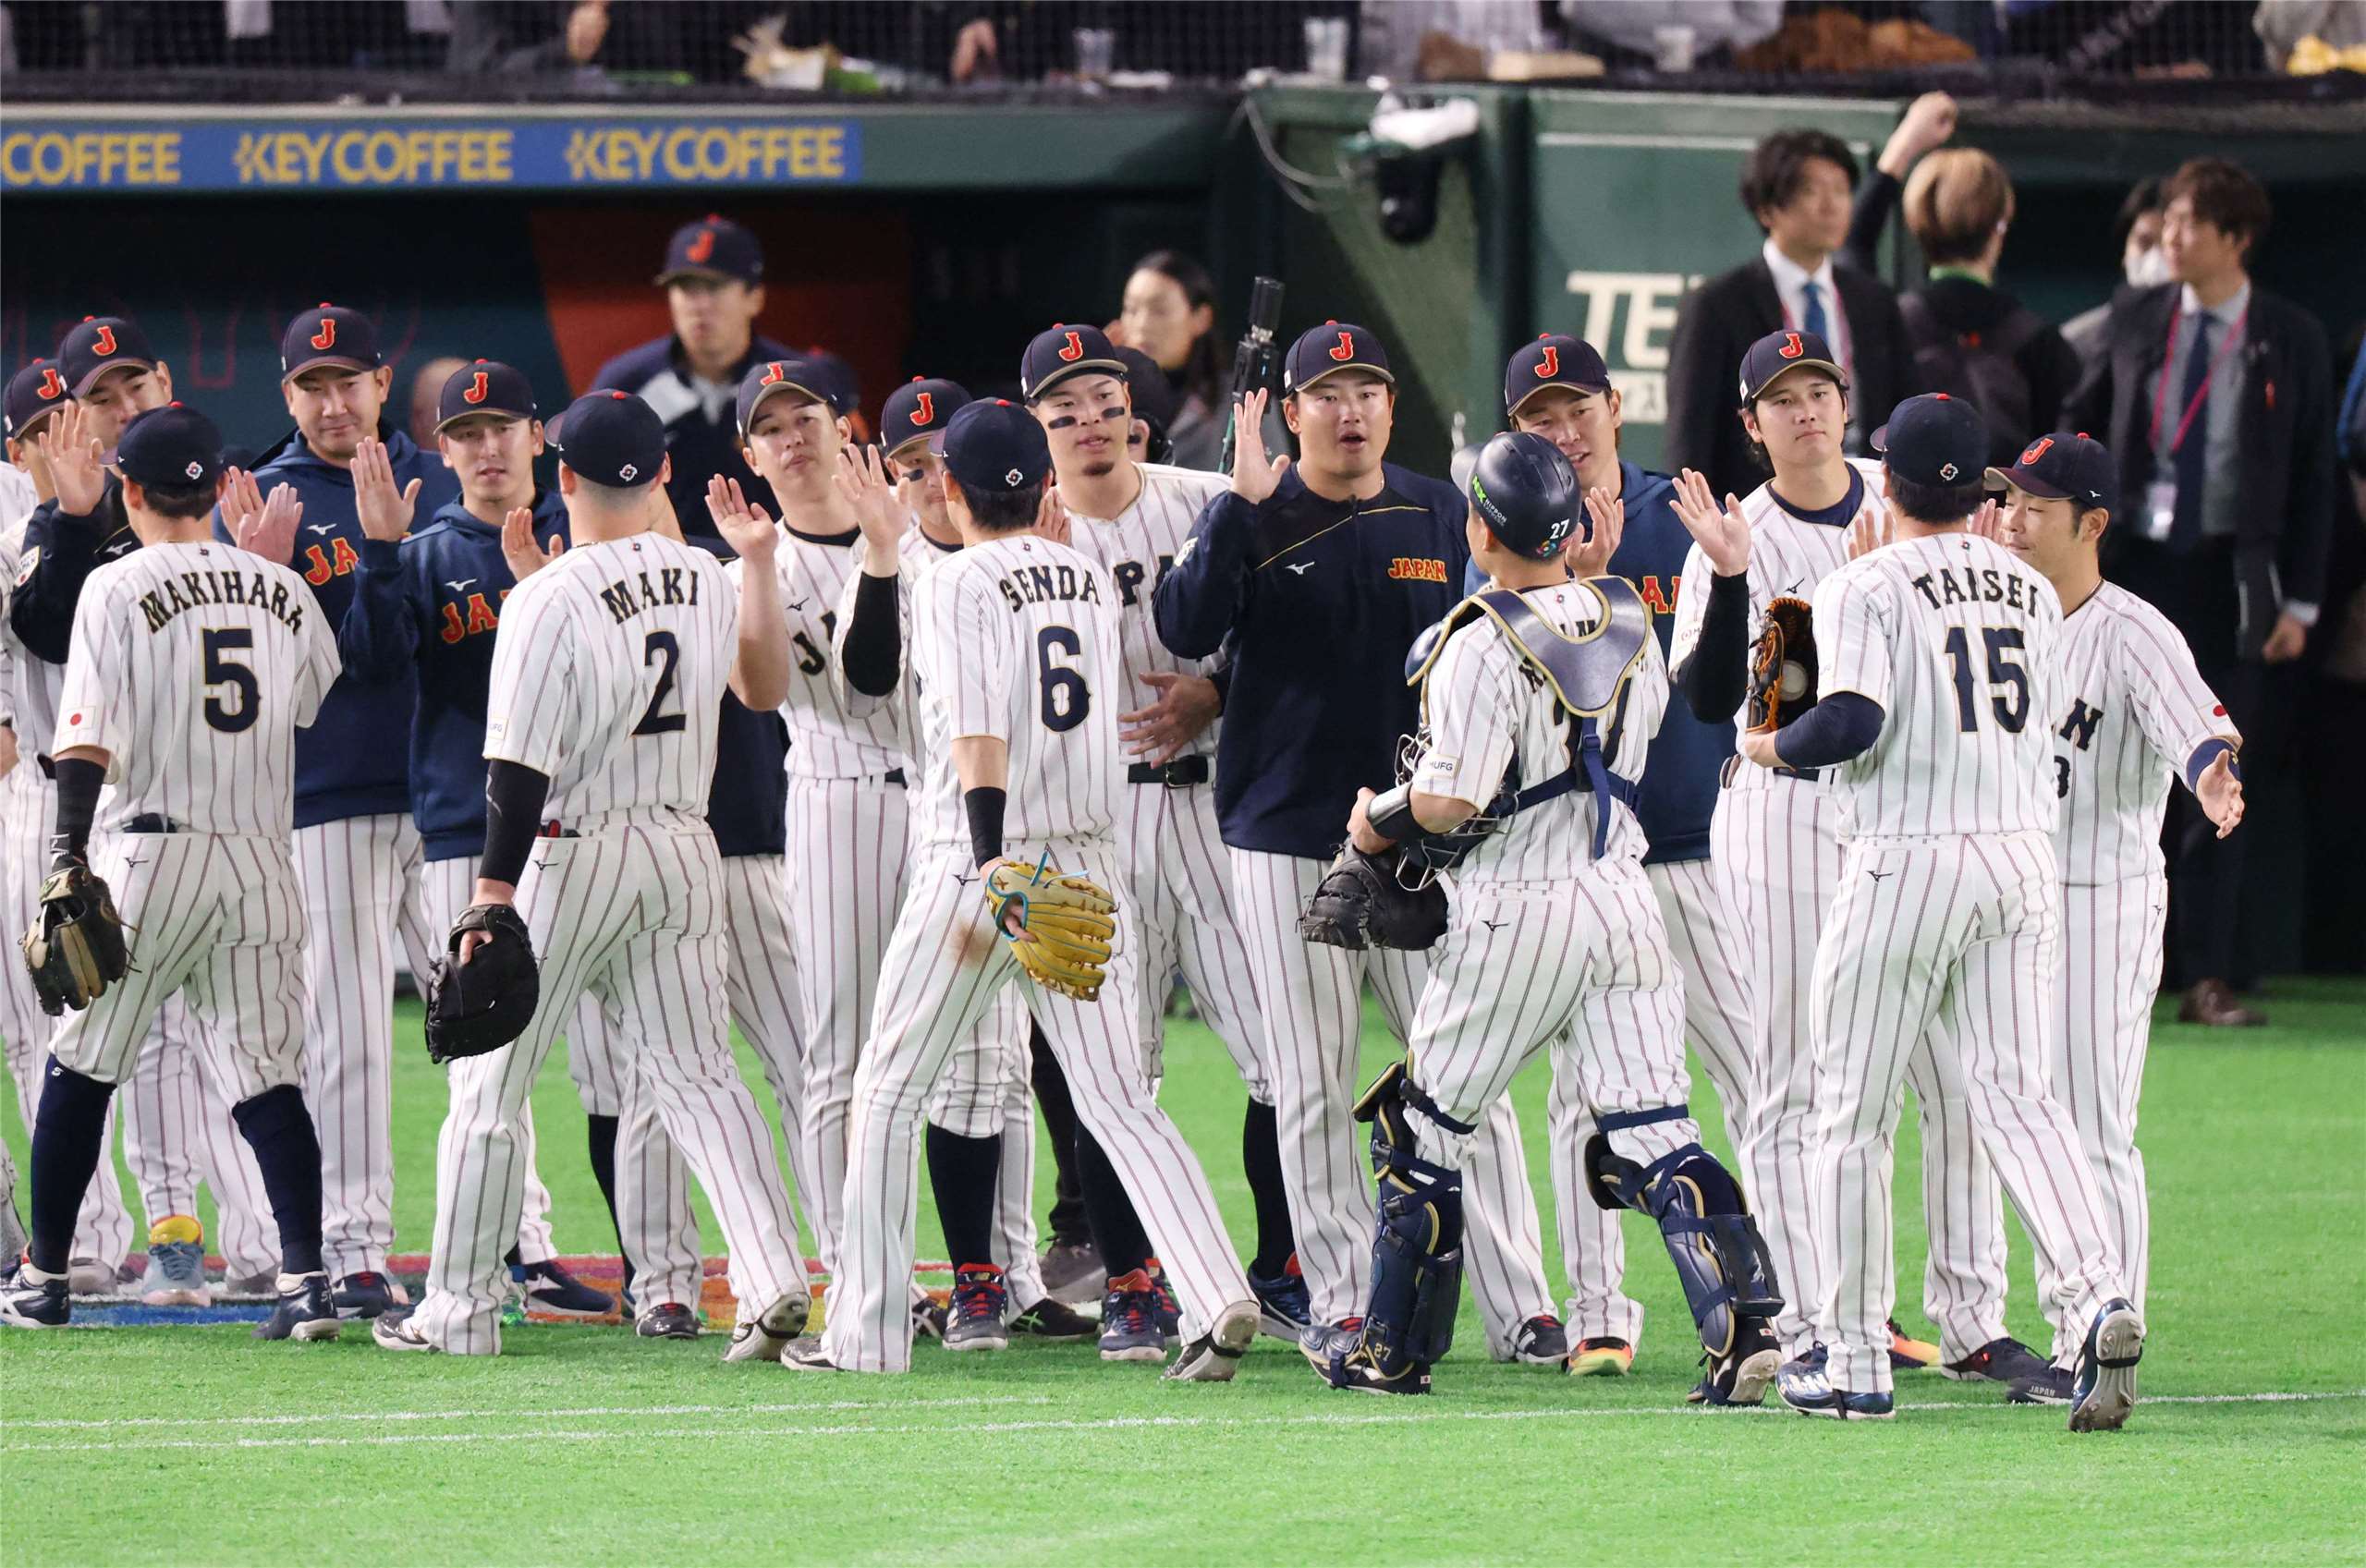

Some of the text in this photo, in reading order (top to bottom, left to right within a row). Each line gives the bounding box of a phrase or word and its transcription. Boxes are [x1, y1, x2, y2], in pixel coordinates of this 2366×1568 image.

[687, 229, 715, 263] J
[92, 325, 117, 357] J
[311, 319, 336, 350] J
[1058, 332, 1083, 361] J
[1329, 332, 1354, 361] J
[1778, 333, 1804, 359] J
[760, 362, 784, 386] J
[1534, 346, 1559, 379] J
[37, 369, 62, 400] J
[463, 371, 488, 404] J
[909, 392, 934, 426] J
[2021, 437, 2055, 465] J
[1482, 498, 1507, 523] NIPPON
[1550, 518, 1570, 540] 27
[1387, 557, 1447, 583] JAPAN
[139, 570, 304, 636] MAKIHARA
[601, 567, 699, 626] MAKI
[1911, 566, 2040, 619] TAISEI
[201, 626, 261, 734] 5
[631, 628, 688, 736] 2
[1036, 623, 1092, 733] 6
[1944, 624, 2031, 735] 15
[1374, 1343, 1392, 1362] 27
[2029, 1385, 2055, 1397] JAPAN
